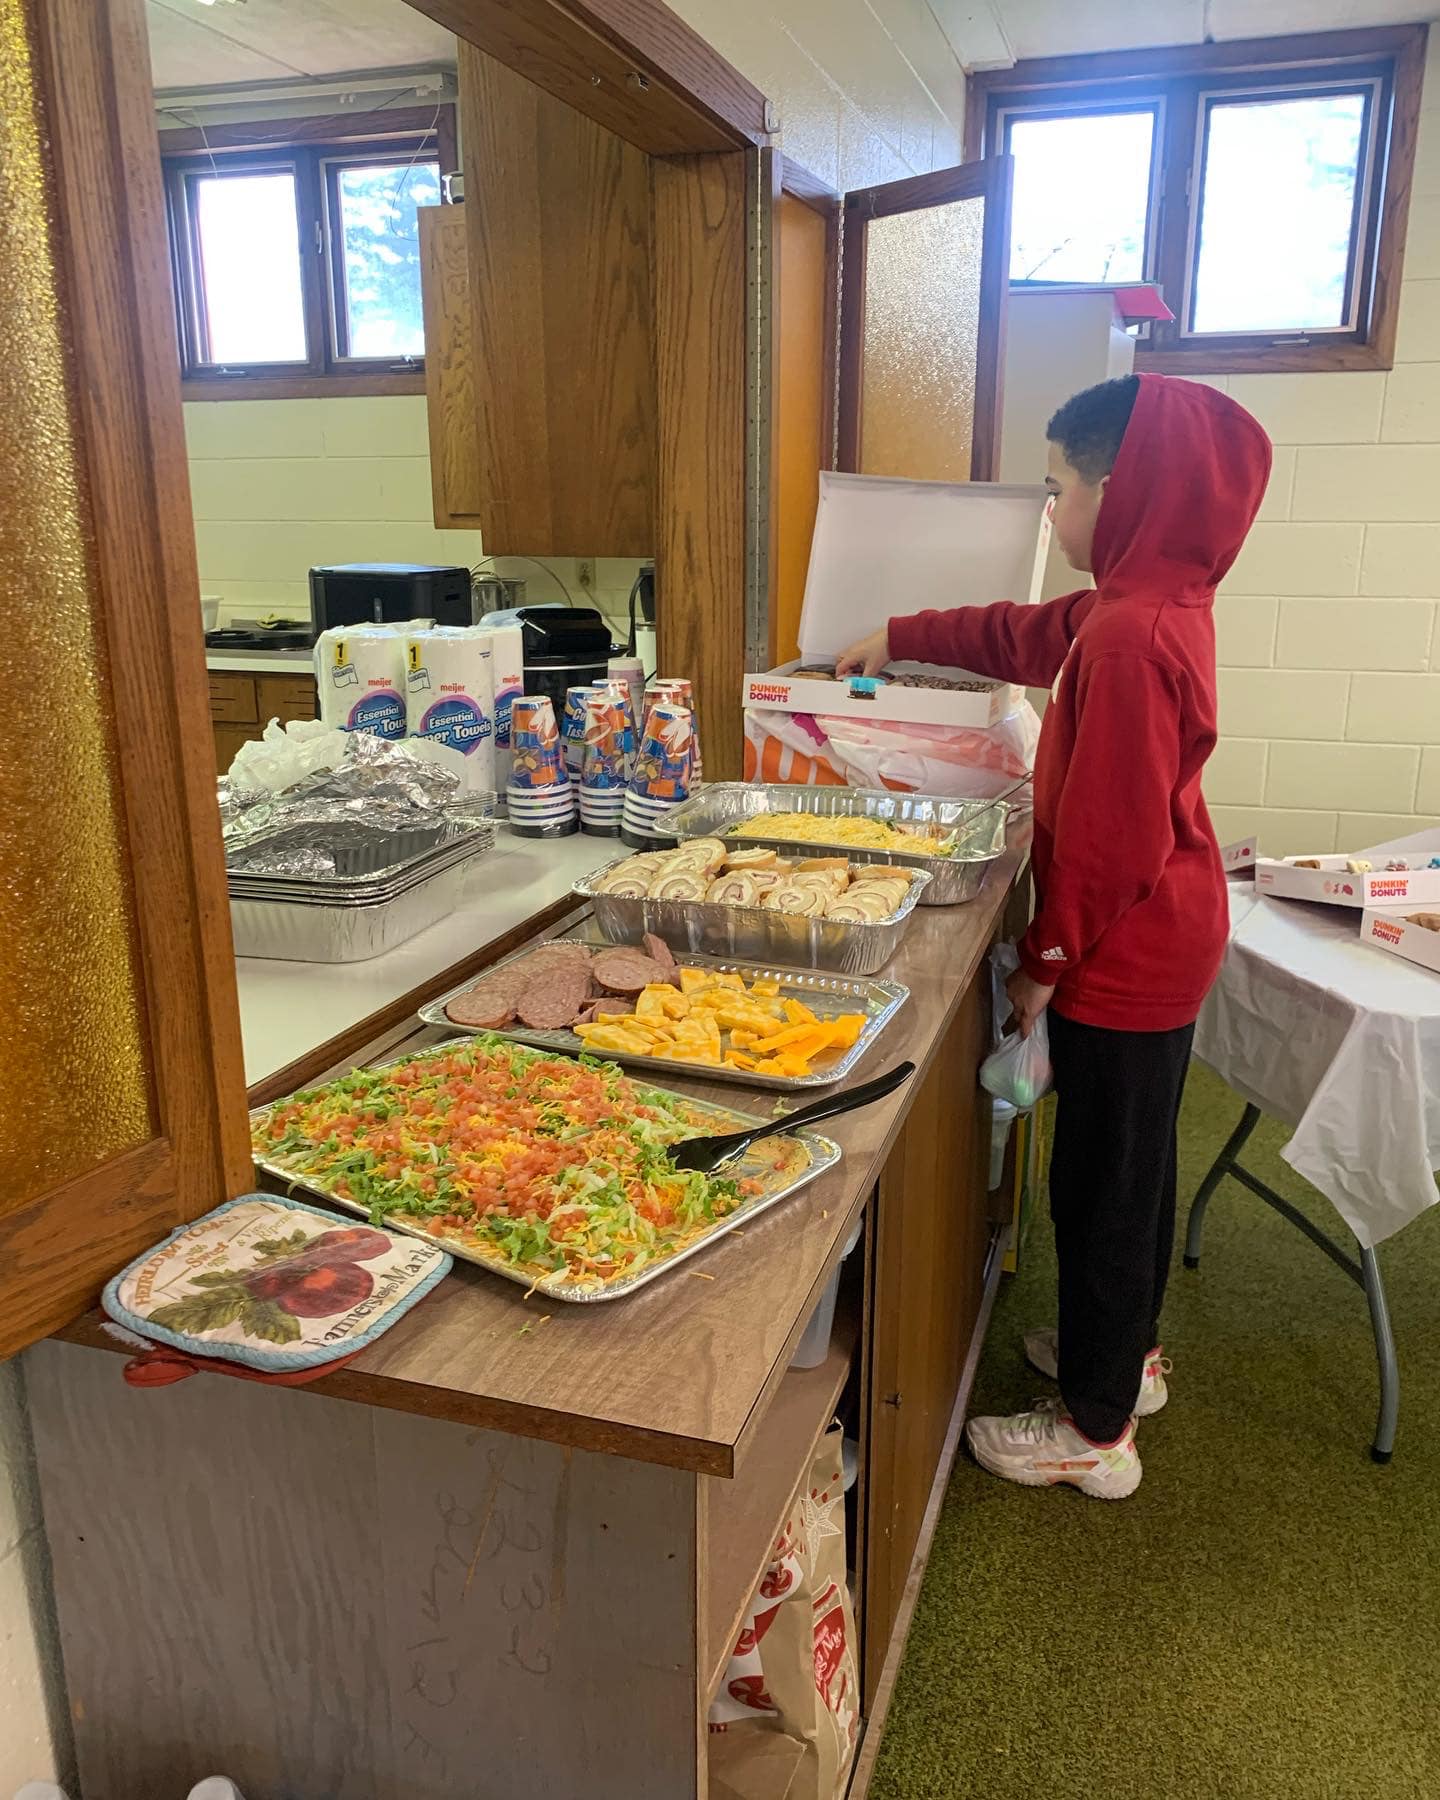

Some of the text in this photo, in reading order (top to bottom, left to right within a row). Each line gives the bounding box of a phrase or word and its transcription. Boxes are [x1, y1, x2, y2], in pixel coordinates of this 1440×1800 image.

[337, 642, 344, 659] 1
[409, 646, 417, 662] 1
[367, 678, 392, 688] meijer
[440, 683, 465, 693] meijer
[750, 683, 792, 695] DUNKIN'
[749, 692, 789, 703] DONUTS
[357, 705, 399, 723] Essential
[429, 713, 474, 729] Essential
[453, 721, 492, 739] Towels
[1370, 879, 1409, 889] DUNKIN'
[1370, 888, 1408, 897] DONUTS
[1371, 927, 1401, 945] DONUTS
[1373, 919, 1405, 937] DUNKIN'
